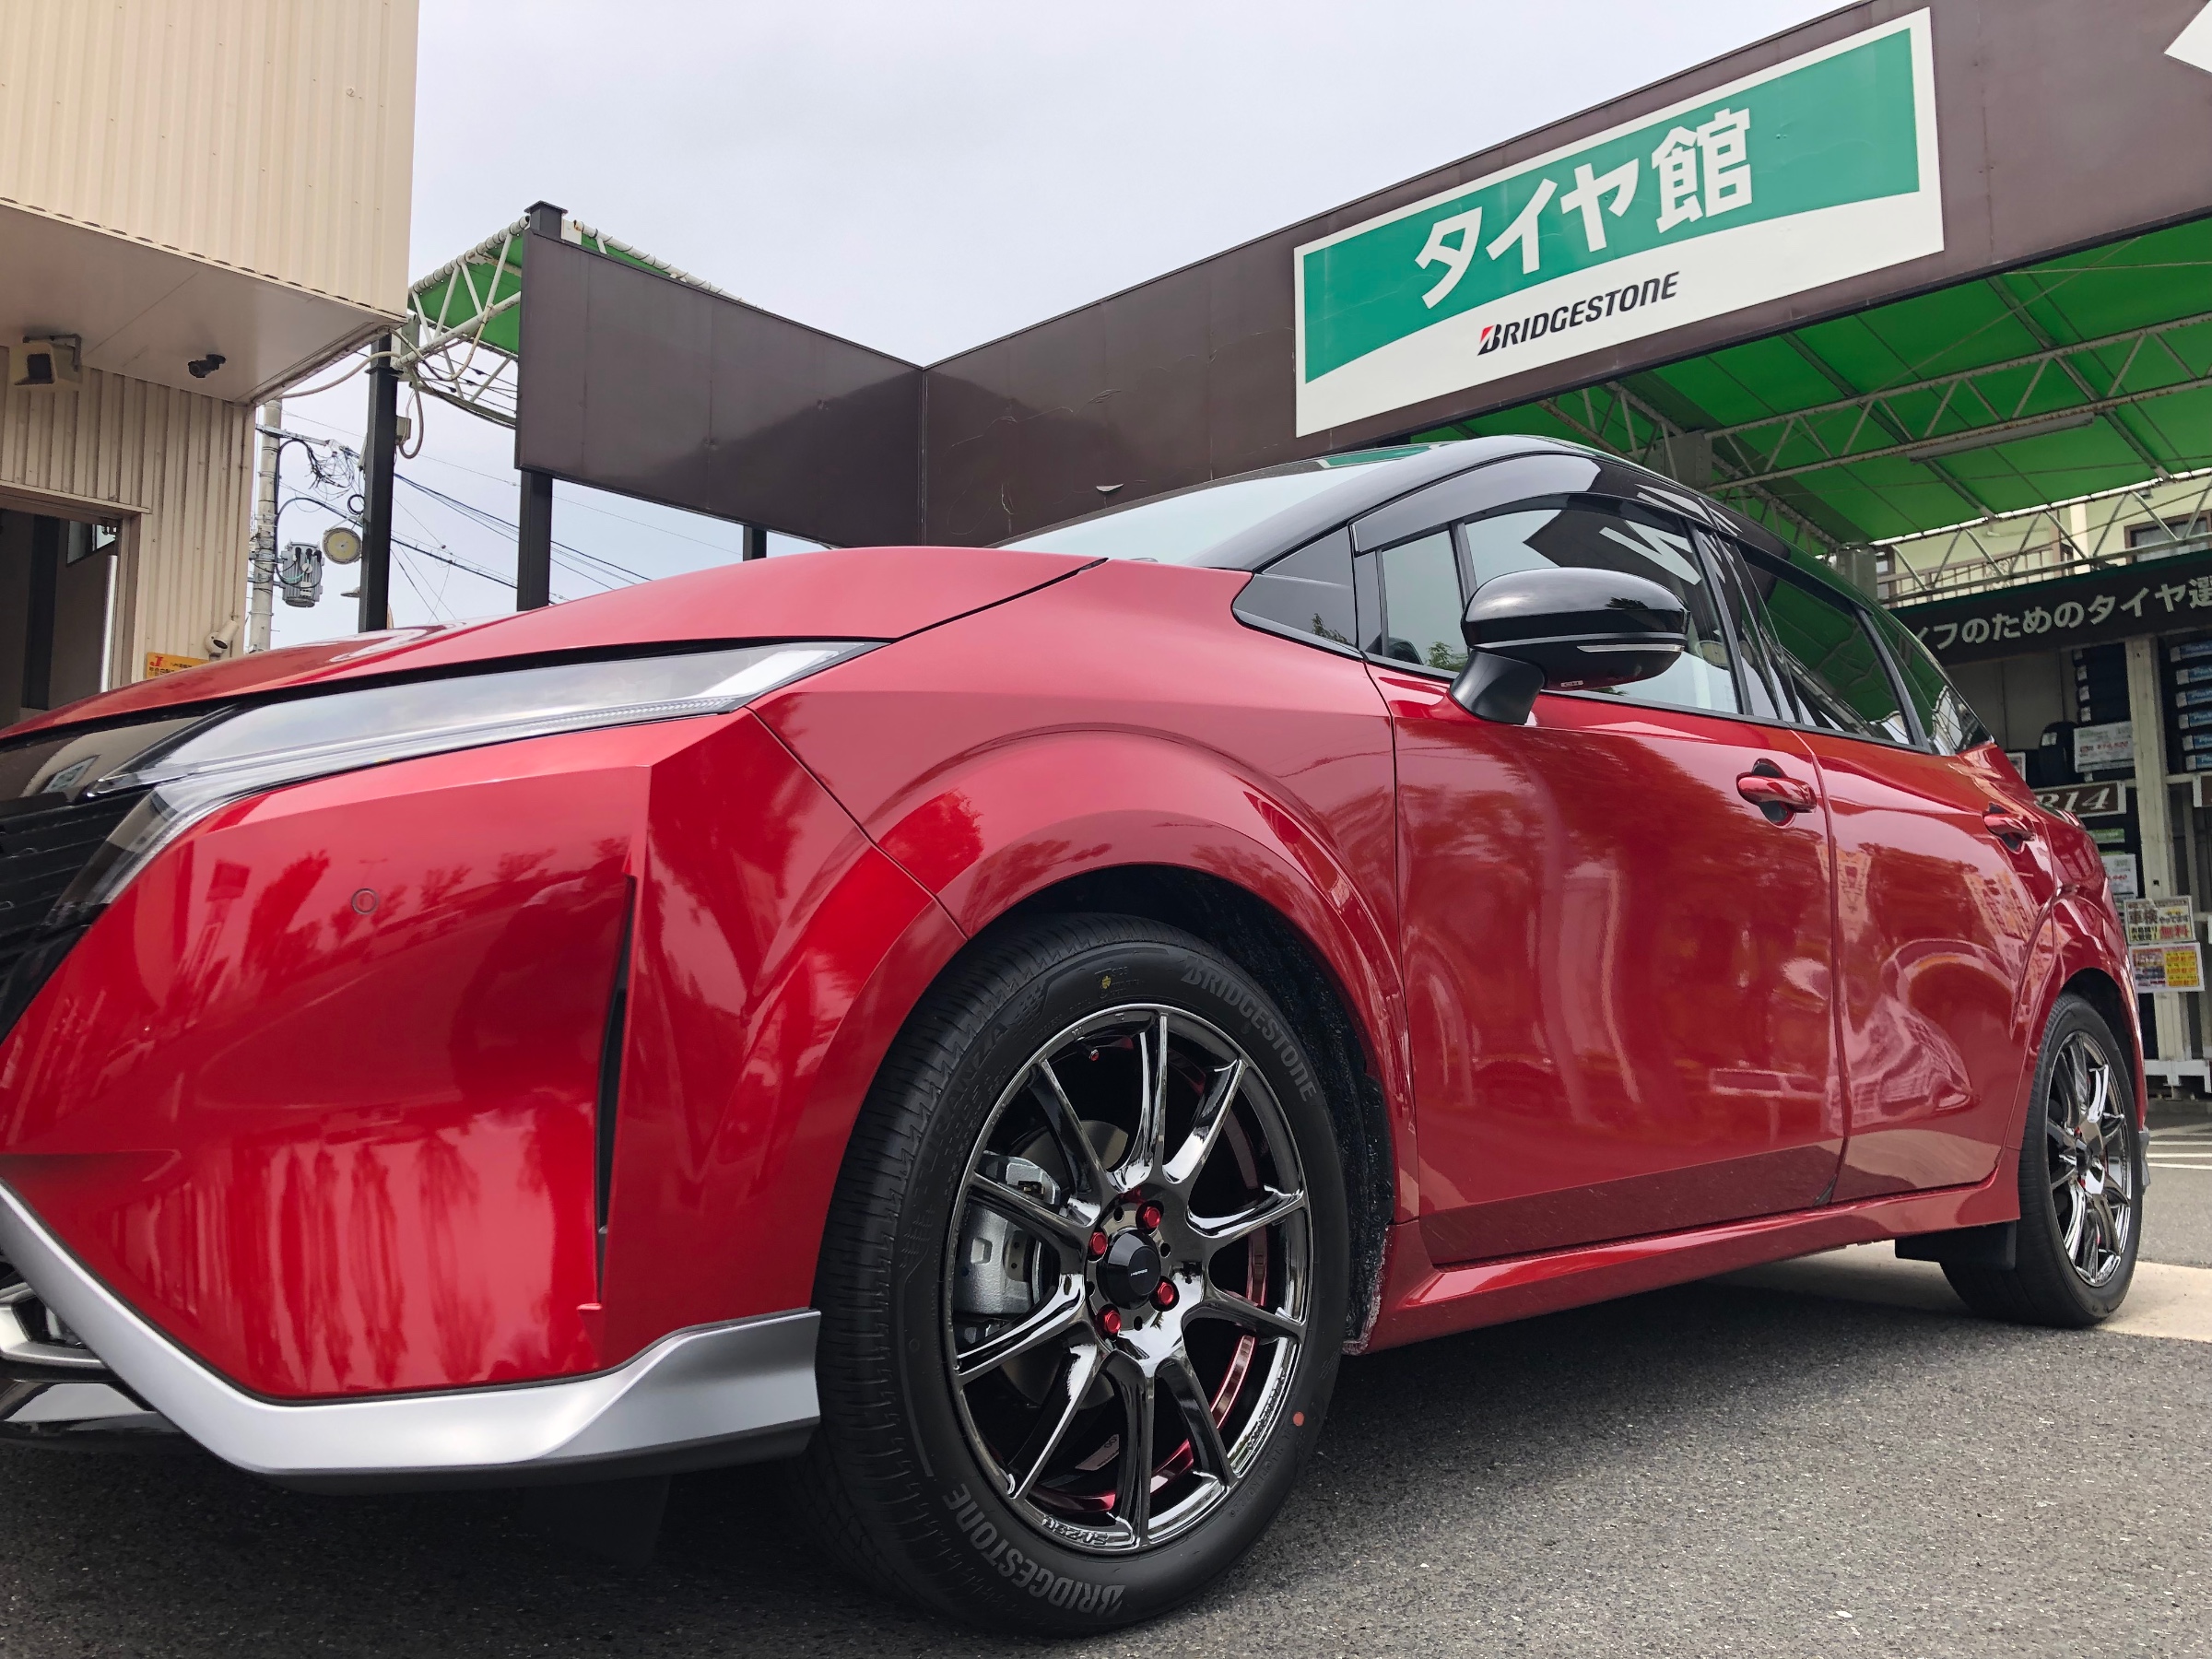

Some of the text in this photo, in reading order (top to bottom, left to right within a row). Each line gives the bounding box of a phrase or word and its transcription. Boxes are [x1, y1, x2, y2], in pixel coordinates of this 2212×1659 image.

[1414, 108, 1752, 310] タイヤ館
[1477, 272, 1679, 356] BRIDGESTONE
[1181, 955, 1318, 1102] BRIDGESTONE
[942, 1483, 1127, 1618] BRIDGESTONE
